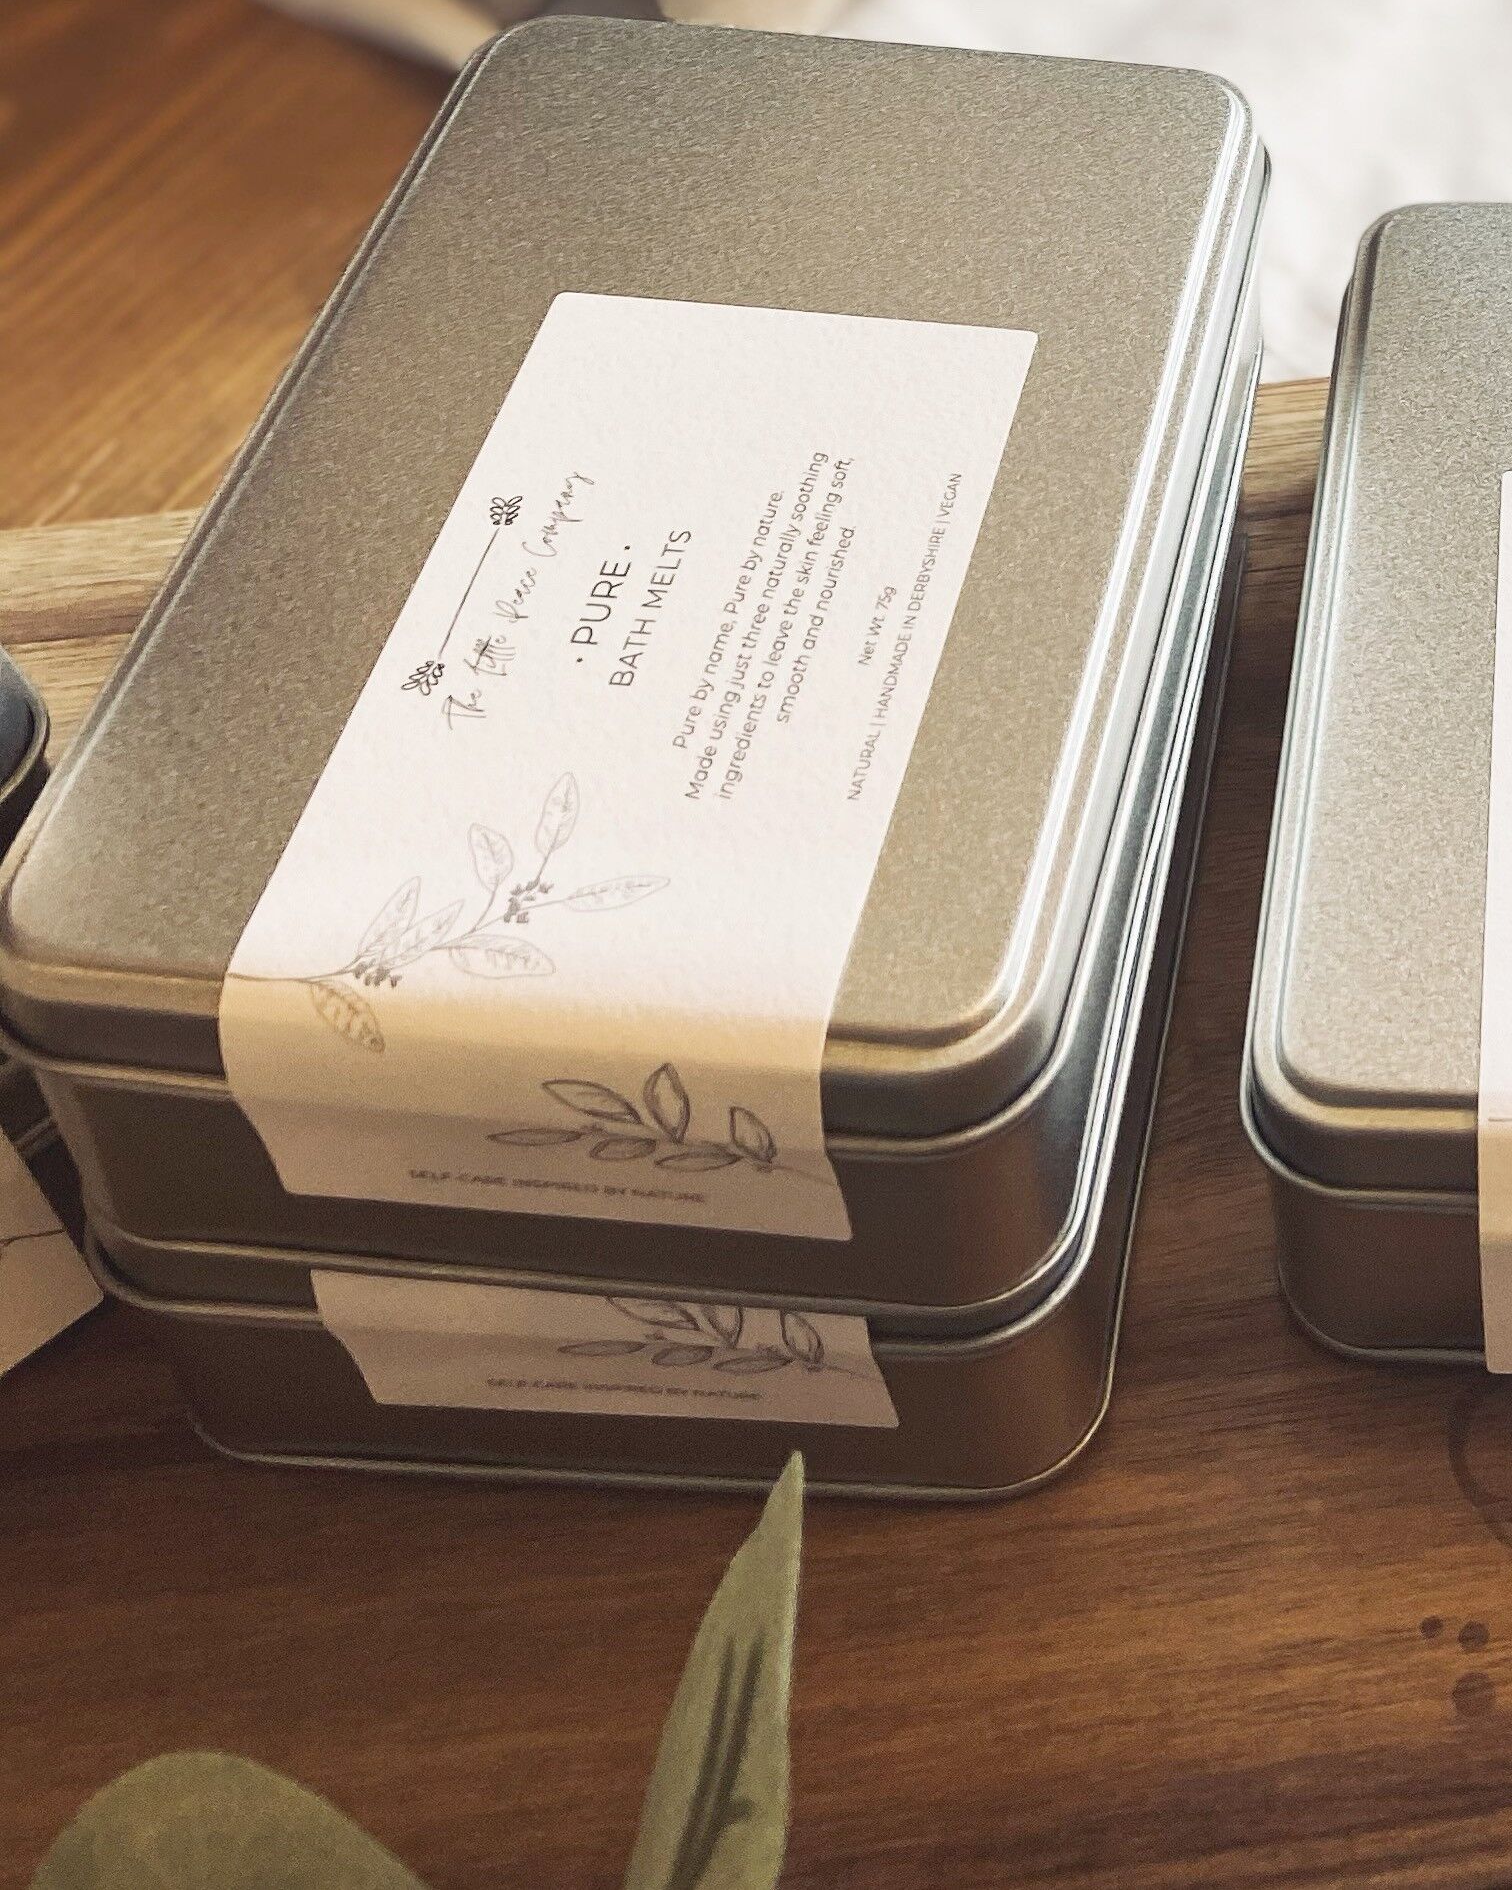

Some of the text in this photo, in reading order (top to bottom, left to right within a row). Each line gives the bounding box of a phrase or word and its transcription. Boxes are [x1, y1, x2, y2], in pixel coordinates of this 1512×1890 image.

[935, 472, 963, 518] VEGAN
[440, 470, 595, 730] The Little Peace Company
[569, 559, 632, 646] PURE
[607, 529, 692, 687] BATH MELTS
[905, 527, 946, 612] DERBYSHIRE
[671, 704, 702, 749] Pure
[688, 677, 715, 701] by
[703, 619, 737, 675] name,
[722, 573, 752, 615] Pure
[739, 548, 763, 571] by
[683, 451, 829, 800] Made using just three naturally soothing
[718, 456, 855, 800] ingredients to leave the skin feeling soft,
[856, 639, 877, 666] Net
[874, 585, 898, 610] 75g
[901, 614, 917, 630] IN
[775, 653, 810, 724] smooth
[801, 613, 825, 650] and
[873, 633, 912, 719] HANDMADE
[845, 730, 881, 801] NATURAL
